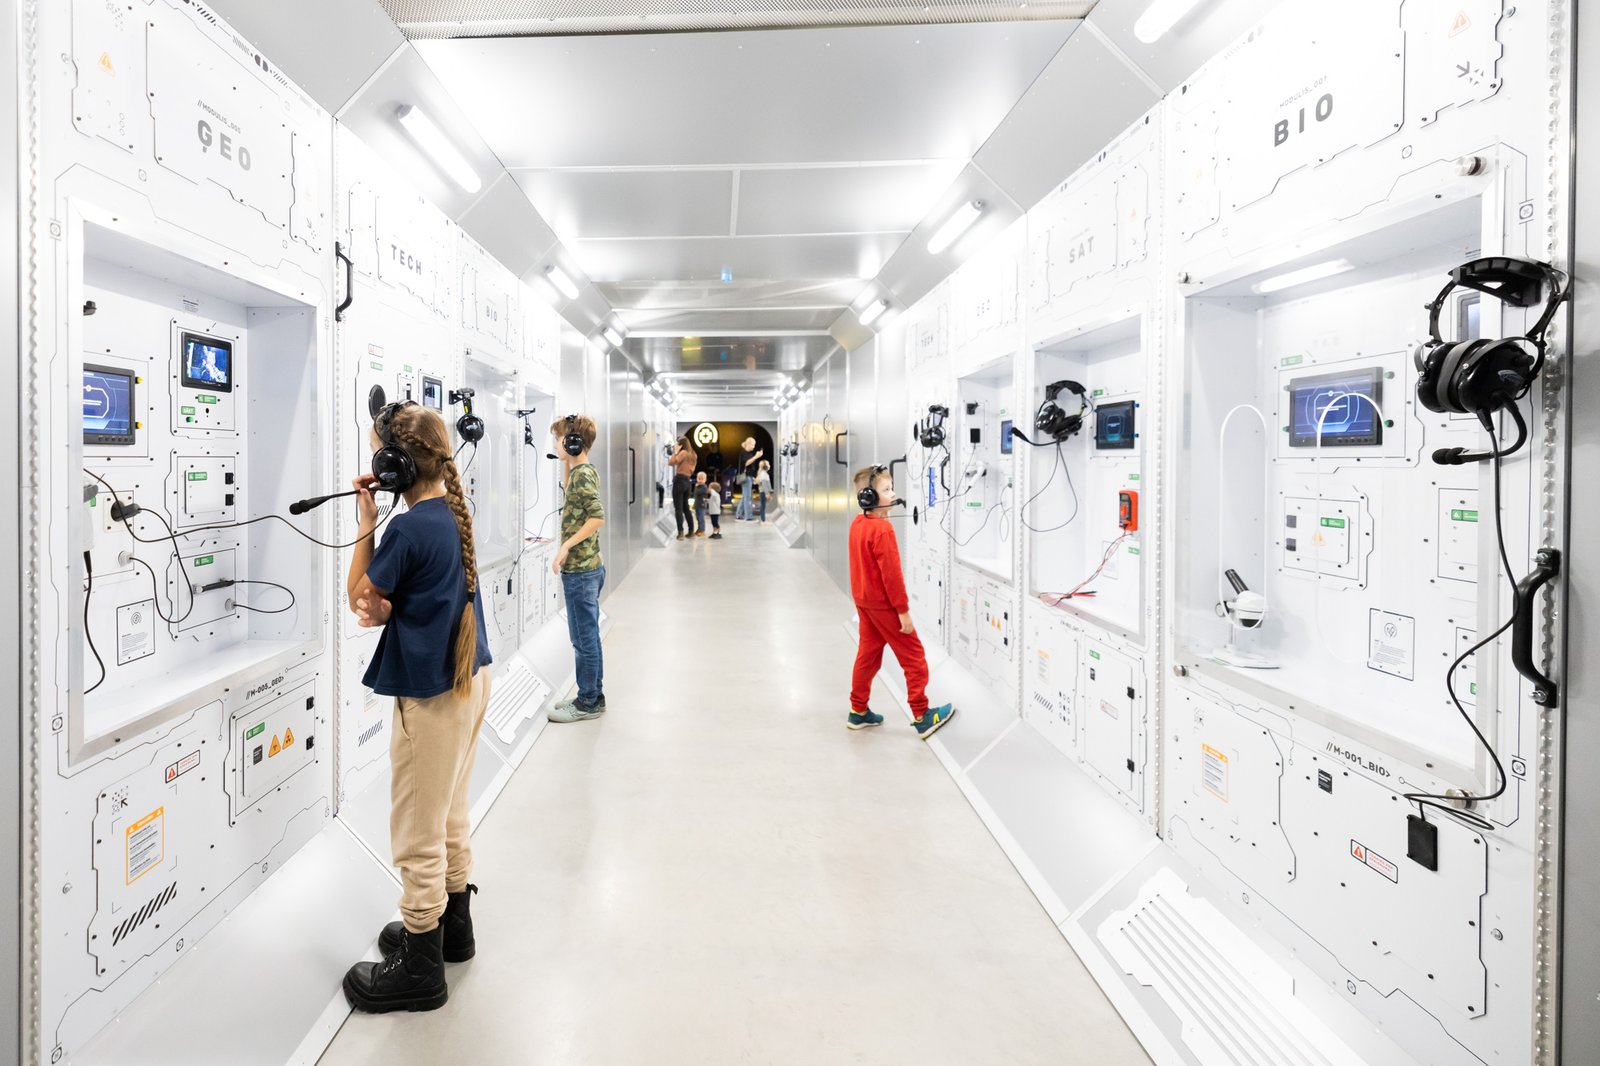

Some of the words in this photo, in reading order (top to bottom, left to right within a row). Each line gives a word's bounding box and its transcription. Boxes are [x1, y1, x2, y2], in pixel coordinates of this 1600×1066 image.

[1274, 93, 1333, 148] BIO
[198, 119, 251, 171] ĢEO
[391, 244, 422, 275] TECH
[1069, 235, 1094, 264] SAT
